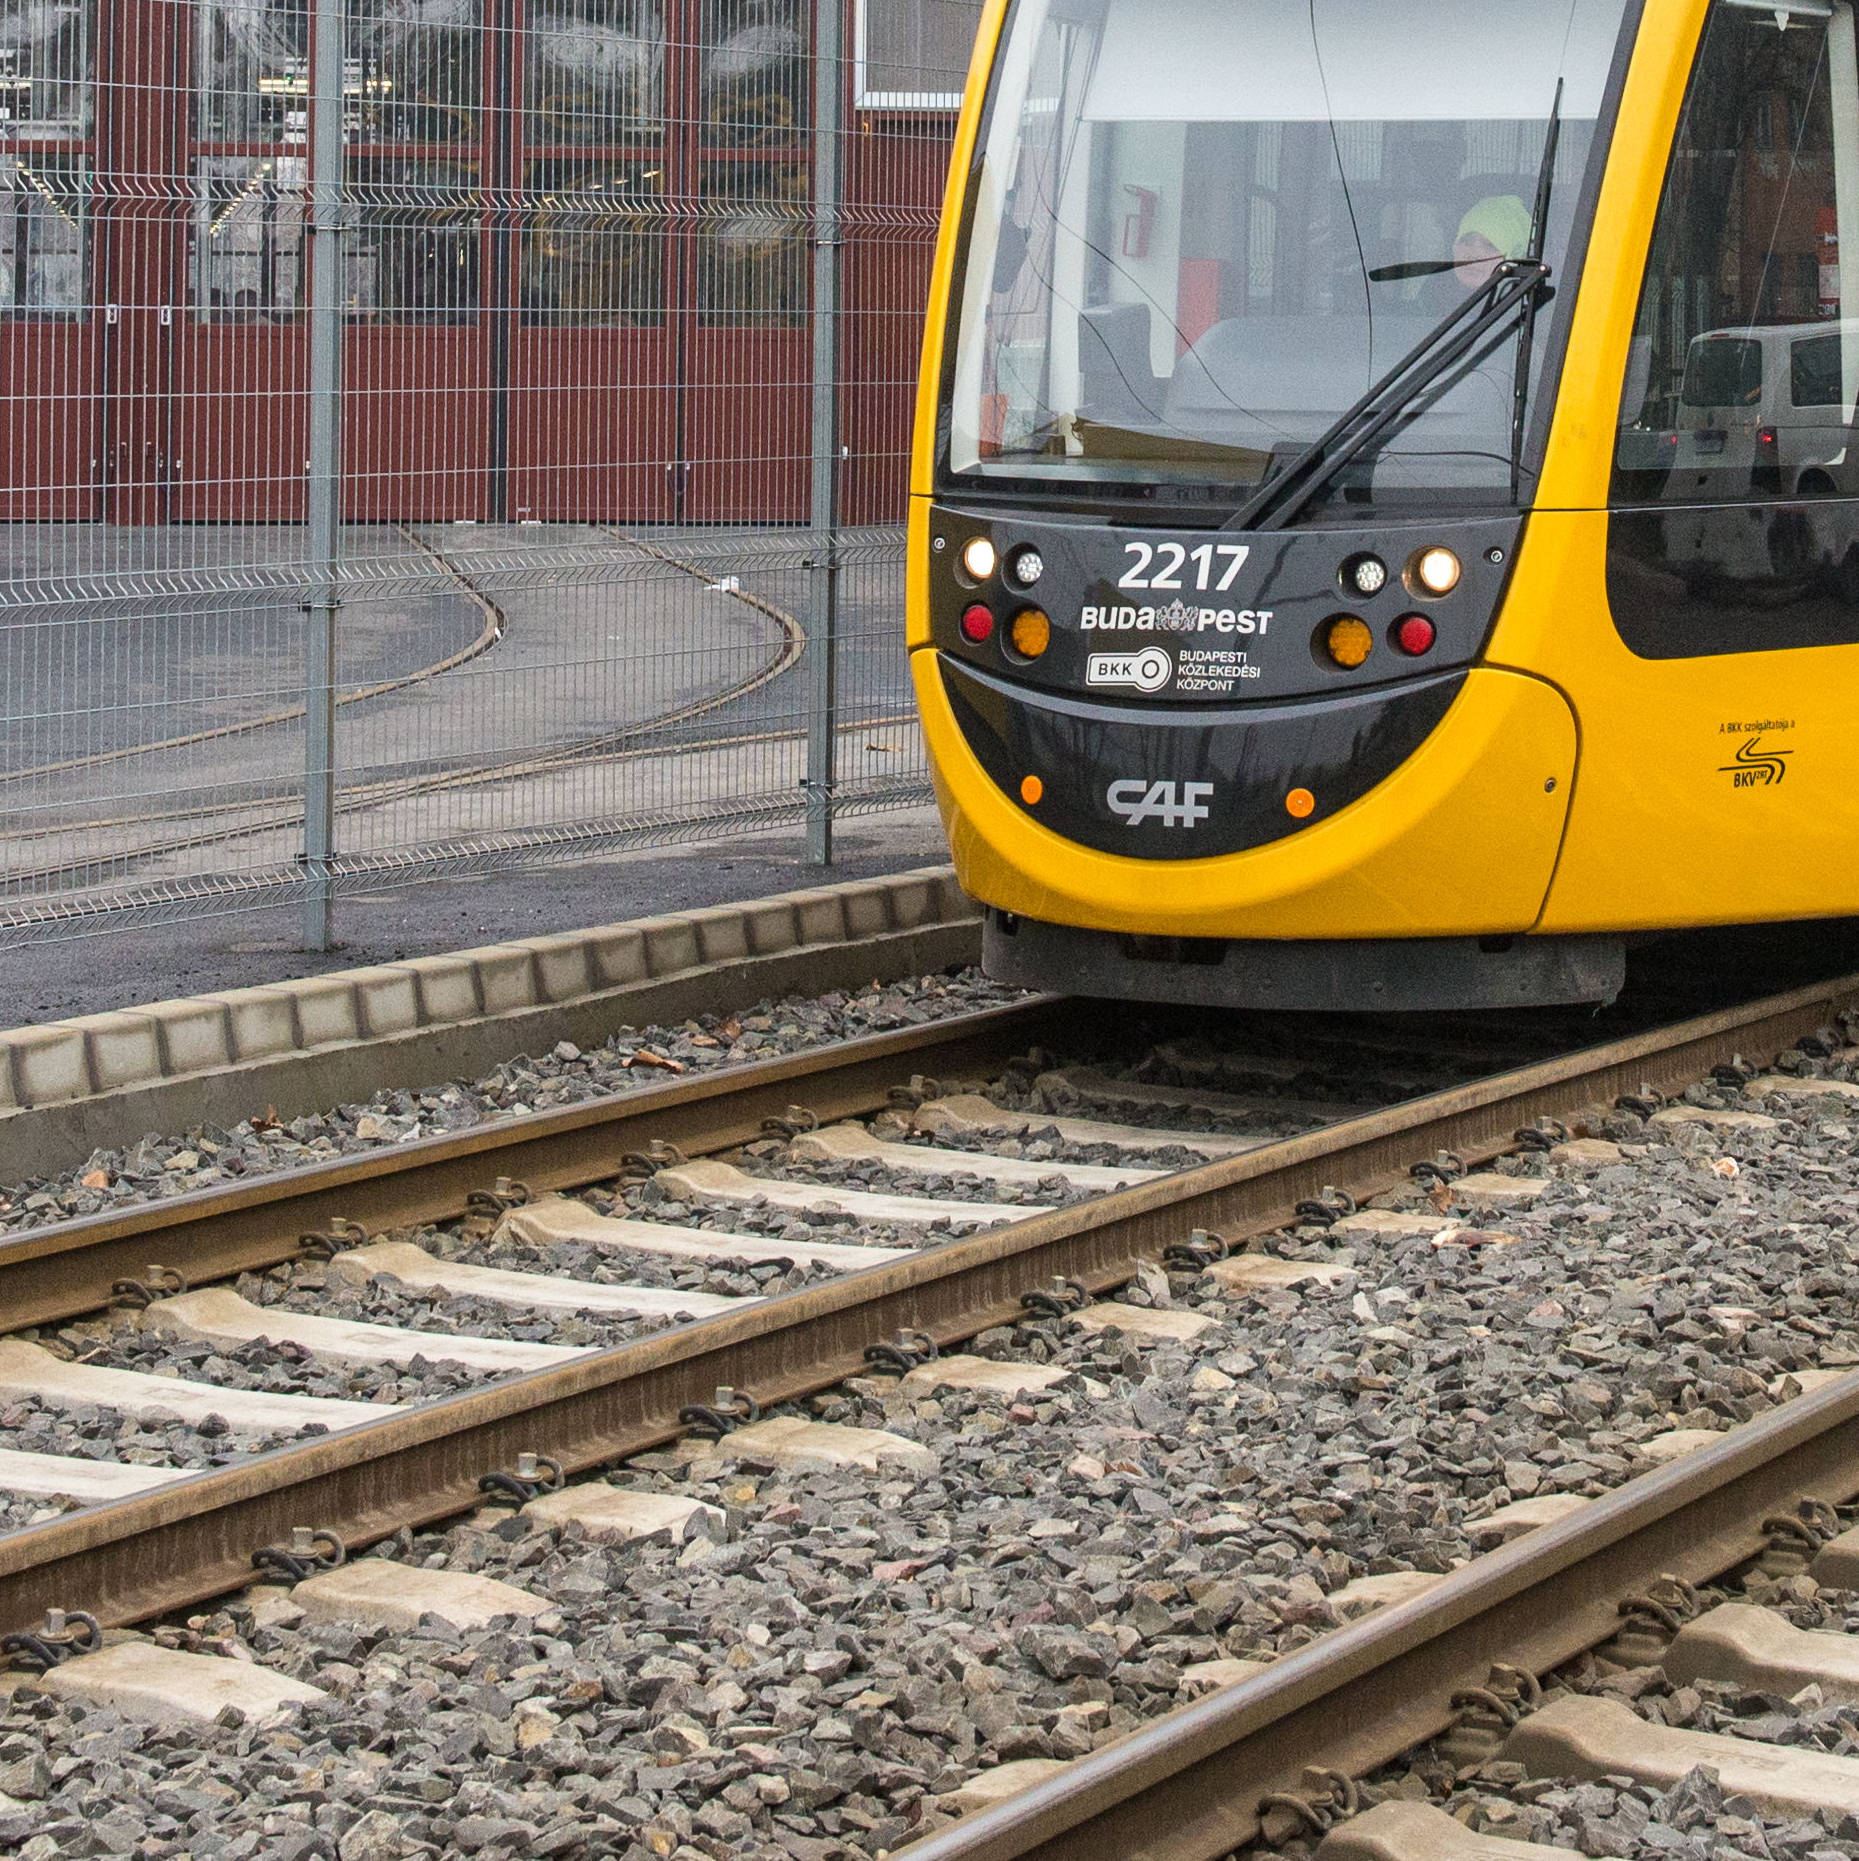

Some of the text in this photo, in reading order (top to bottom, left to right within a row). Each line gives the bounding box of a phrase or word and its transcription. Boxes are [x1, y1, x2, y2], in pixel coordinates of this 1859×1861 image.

[1117, 541, 1250, 591] 2217
[1179, 649, 1247, 664] BUDAPESTI
[1098, 662, 1133, 676] BKK
[1177, 662, 1261, 679] KÖZLEKEDÉSI
[1176, 677, 1235, 692] KÖZPONT
[1733, 771, 1756, 788] BKV
[1106, 779, 1214, 828] CAF
